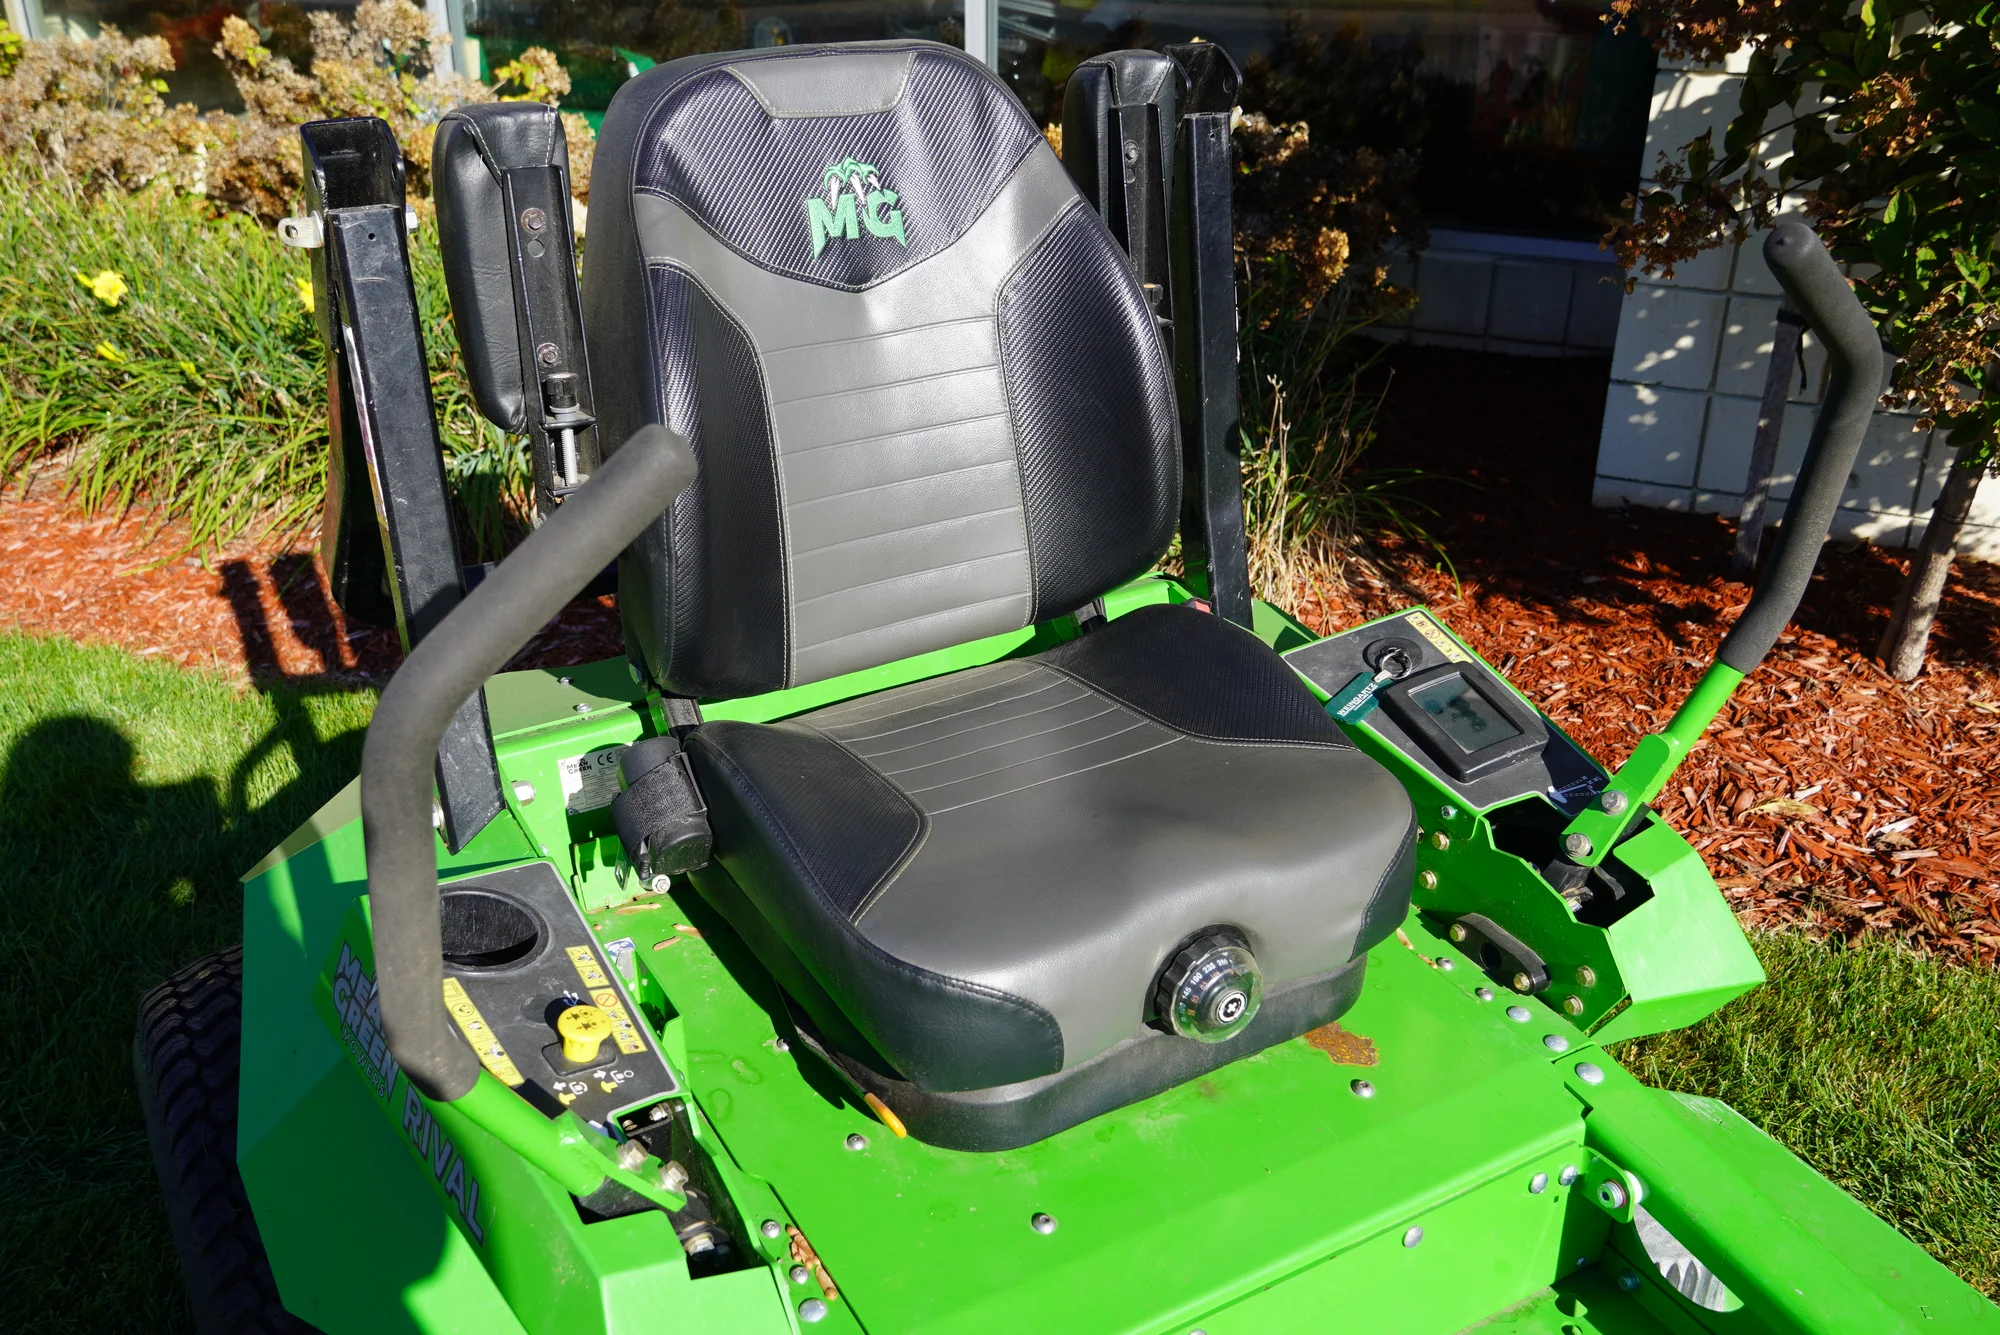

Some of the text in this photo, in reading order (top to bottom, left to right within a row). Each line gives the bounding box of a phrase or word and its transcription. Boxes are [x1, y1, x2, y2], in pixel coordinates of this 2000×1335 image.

[807, 188, 906, 260] MG
[1337, 683, 1375, 715] WEINGARTZ
[567, 760, 588, 770] MEAN
[568, 765, 592, 775] GREEN
[597, 752, 614, 766] CE
[334, 940, 385, 1038] MEA
[1182, 987, 1192, 999] 145
[1190, 972, 1203, 985] 190
[1202, 962, 1216, 974] 235
[333, 977, 400, 1105] GREEN
[342, 1027, 386, 1097] MOWERS
[403, 1081, 484, 1248] RIVAL
